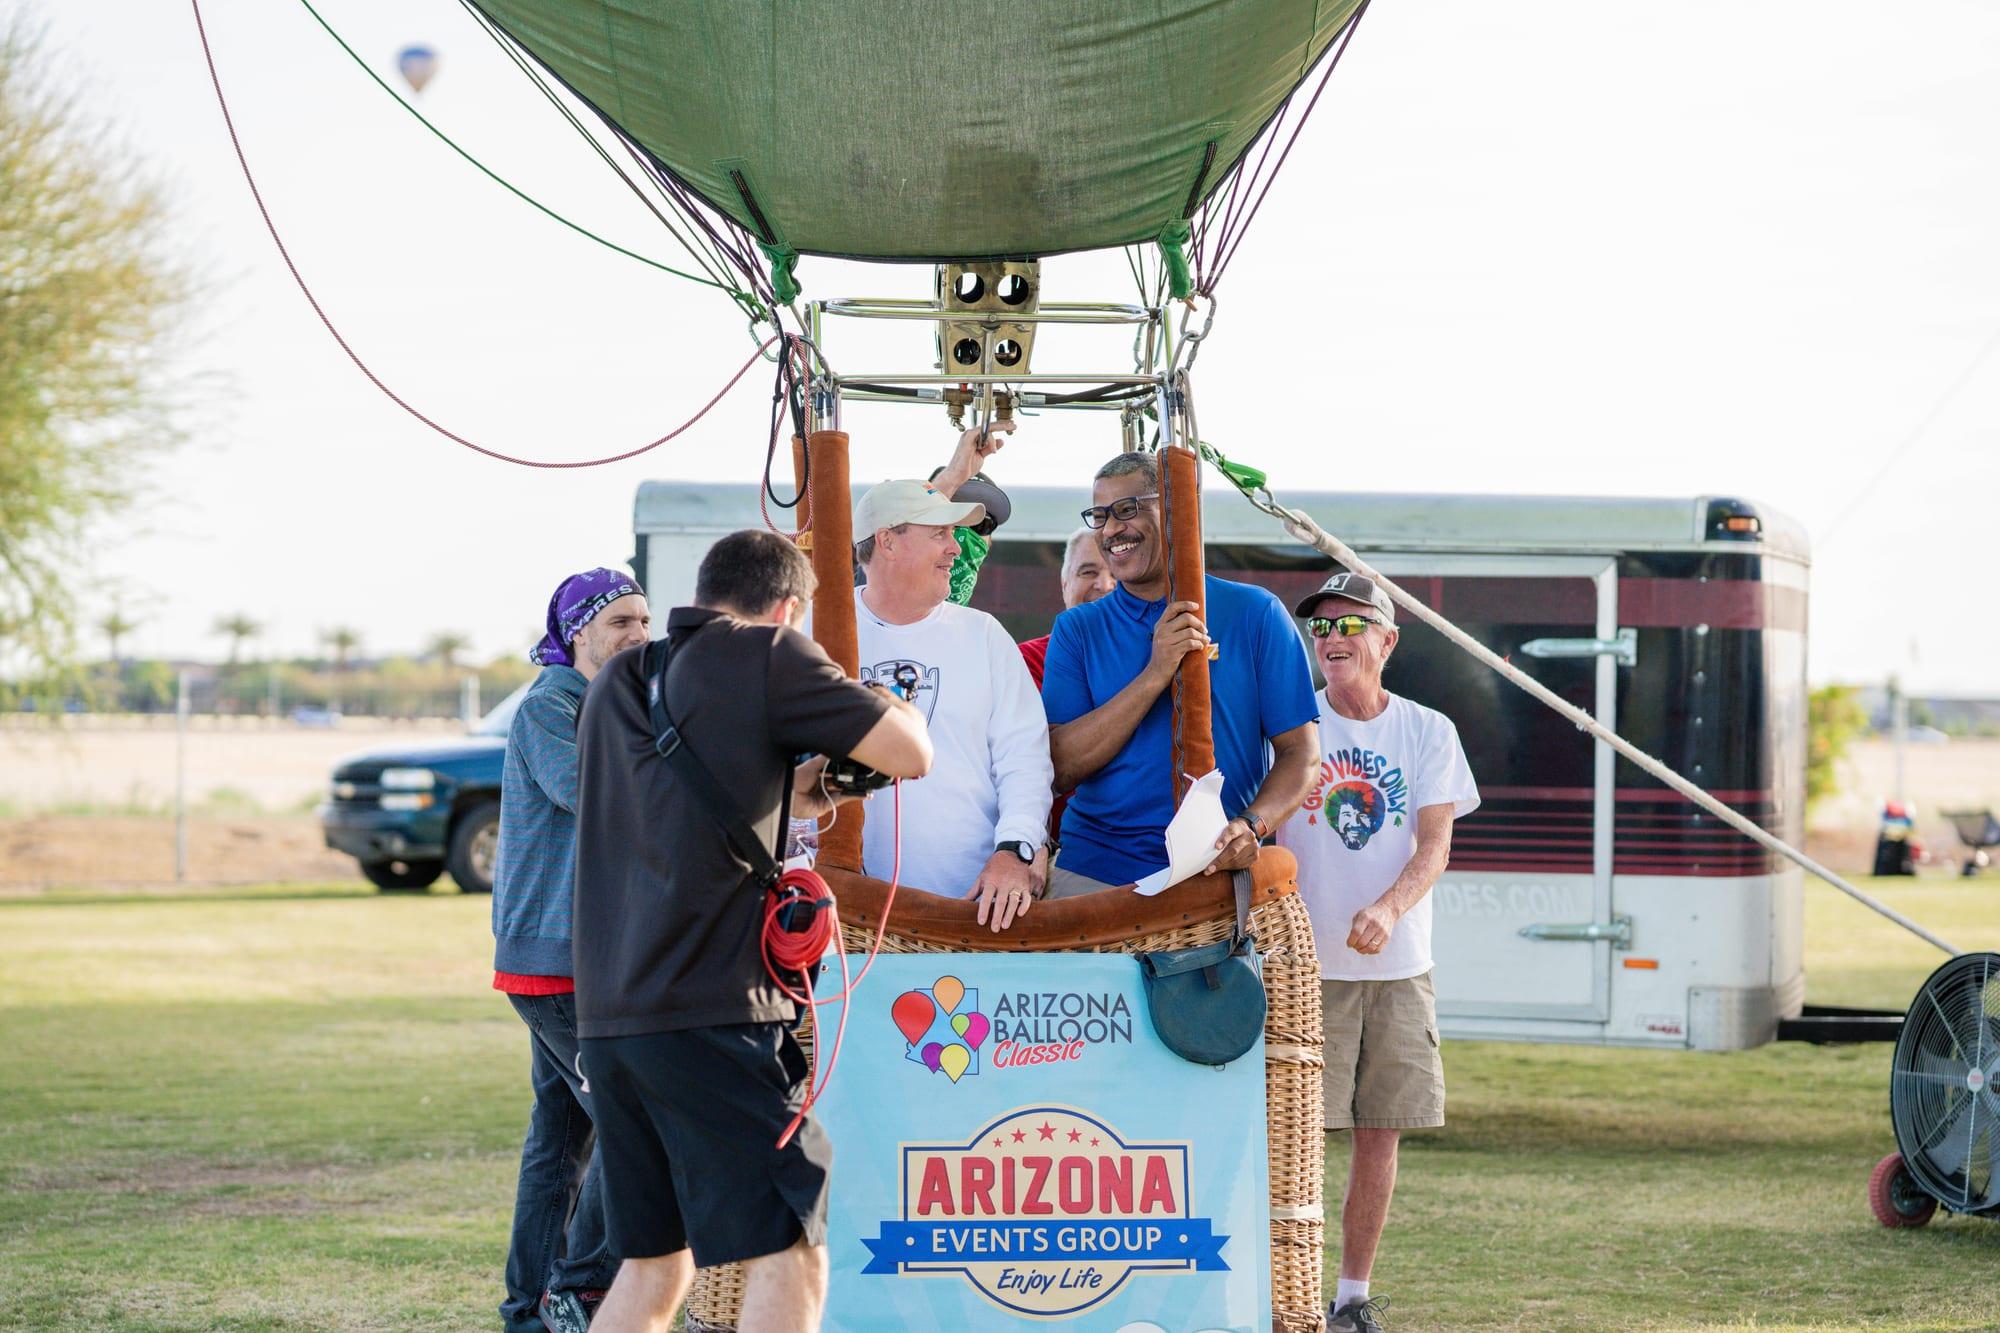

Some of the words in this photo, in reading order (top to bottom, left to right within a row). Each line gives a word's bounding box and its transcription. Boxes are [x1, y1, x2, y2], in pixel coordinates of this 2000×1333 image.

[567, 584, 633, 642] CYPRES
[1328, 747, 1387, 779] VIBES
[1378, 767, 1409, 816] ONLY
[993, 992, 1132, 1018] ARIZONA
[993, 1018, 1132, 1044] BALLOON
[992, 1036, 1086, 1069] Classic
[916, 1155, 1177, 1216] ARIZONA
[932, 1227, 1049, 1253] EVENTS
[1056, 1226, 1162, 1252] GROUP
[996, 1267, 1057, 1295] Enjoy
[1058, 1265, 1104, 1290] Life
